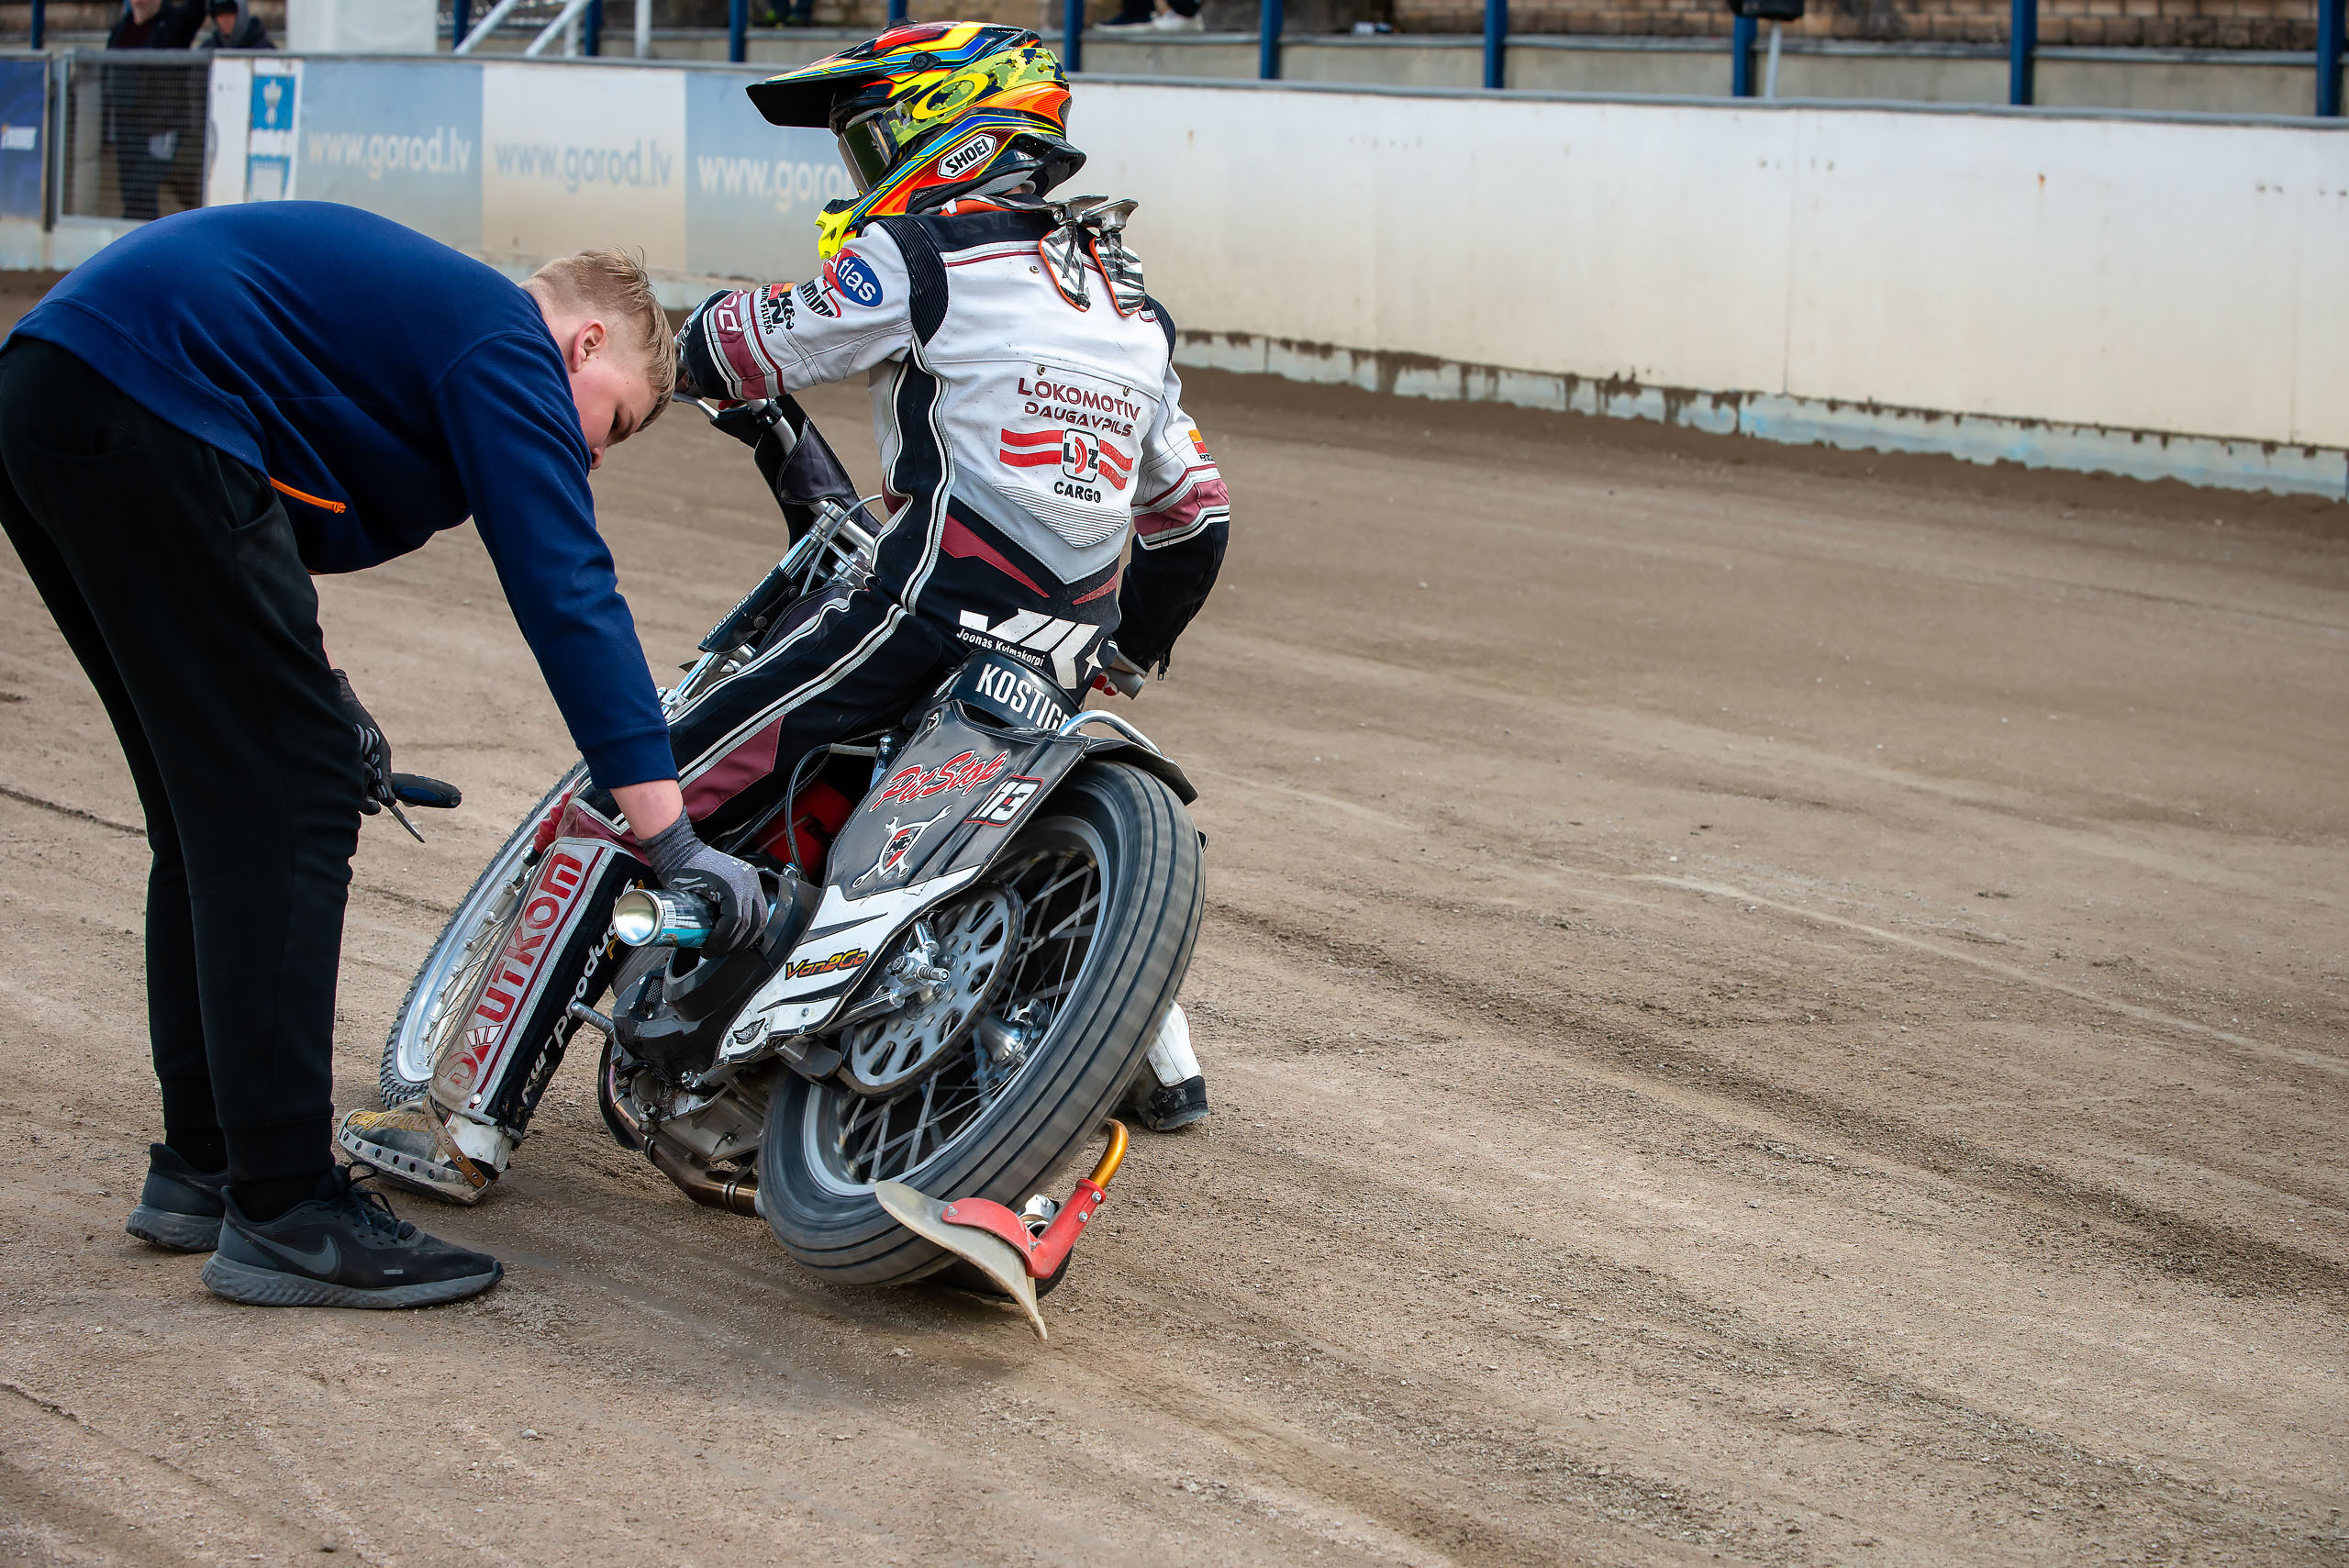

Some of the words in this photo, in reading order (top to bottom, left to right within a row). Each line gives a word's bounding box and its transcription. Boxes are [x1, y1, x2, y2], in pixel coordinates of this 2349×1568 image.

[307, 127, 472, 180] www.gorod.lv
[494, 139, 673, 194] www.gorod.lv
[945, 139, 990, 173] SHOEI
[826, 252, 876, 301] Atlas
[761, 304, 774, 335] FILTERS
[1018, 377, 1141, 421] LOKOMOTIV
[1024, 401, 1134, 437] DAUGAVPILS
[1054, 481, 1101, 503] CARGO
[956, 628, 993, 650] Joonas
[785, 948, 869, 981] Van2Go
